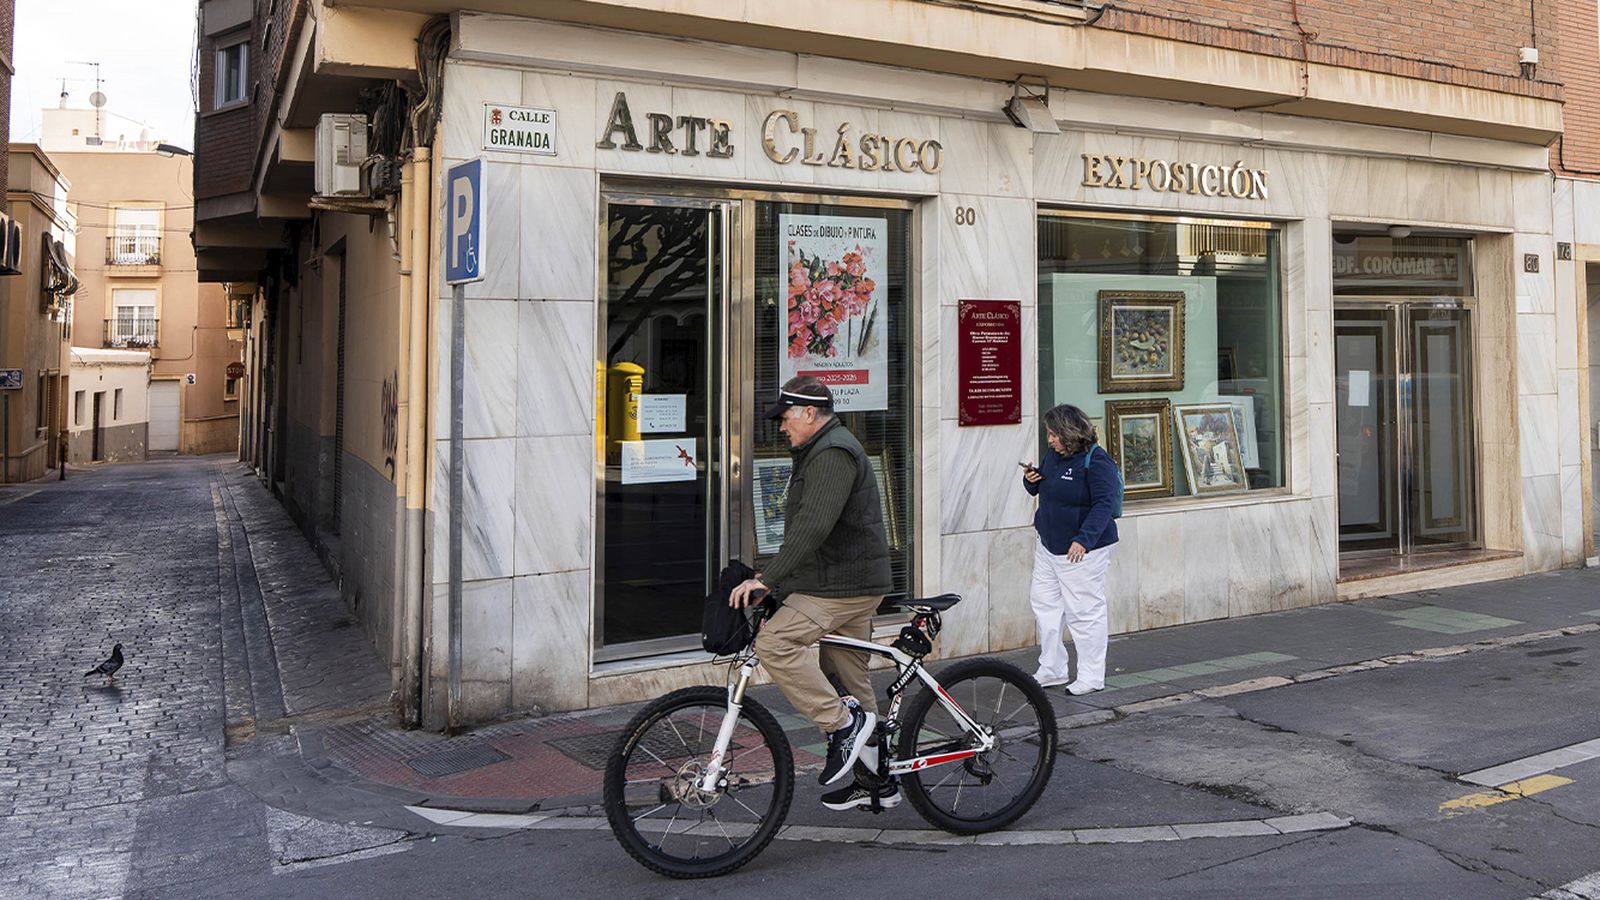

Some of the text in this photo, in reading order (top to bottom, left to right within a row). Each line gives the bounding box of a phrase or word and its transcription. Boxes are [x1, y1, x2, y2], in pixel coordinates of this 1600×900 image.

[509, 110, 550, 124] CALLE
[491, 128, 550, 149] GRANADA
[596, 91, 945, 175] ARTE CLÁSICO
[1081, 153, 1269, 200] EXPOSICIÓN
[452, 176, 473, 268] P
[955, 206, 976, 226] 80
[788, 224, 813, 237] CLASES
[820, 225, 844, 238] DIBUJO
[848, 227, 877, 240] PINTURA
[1558, 243, 1571, 260] 78
[1363, 255, 1436, 276] COROMAR
[1526, 255, 1539, 272] 80
